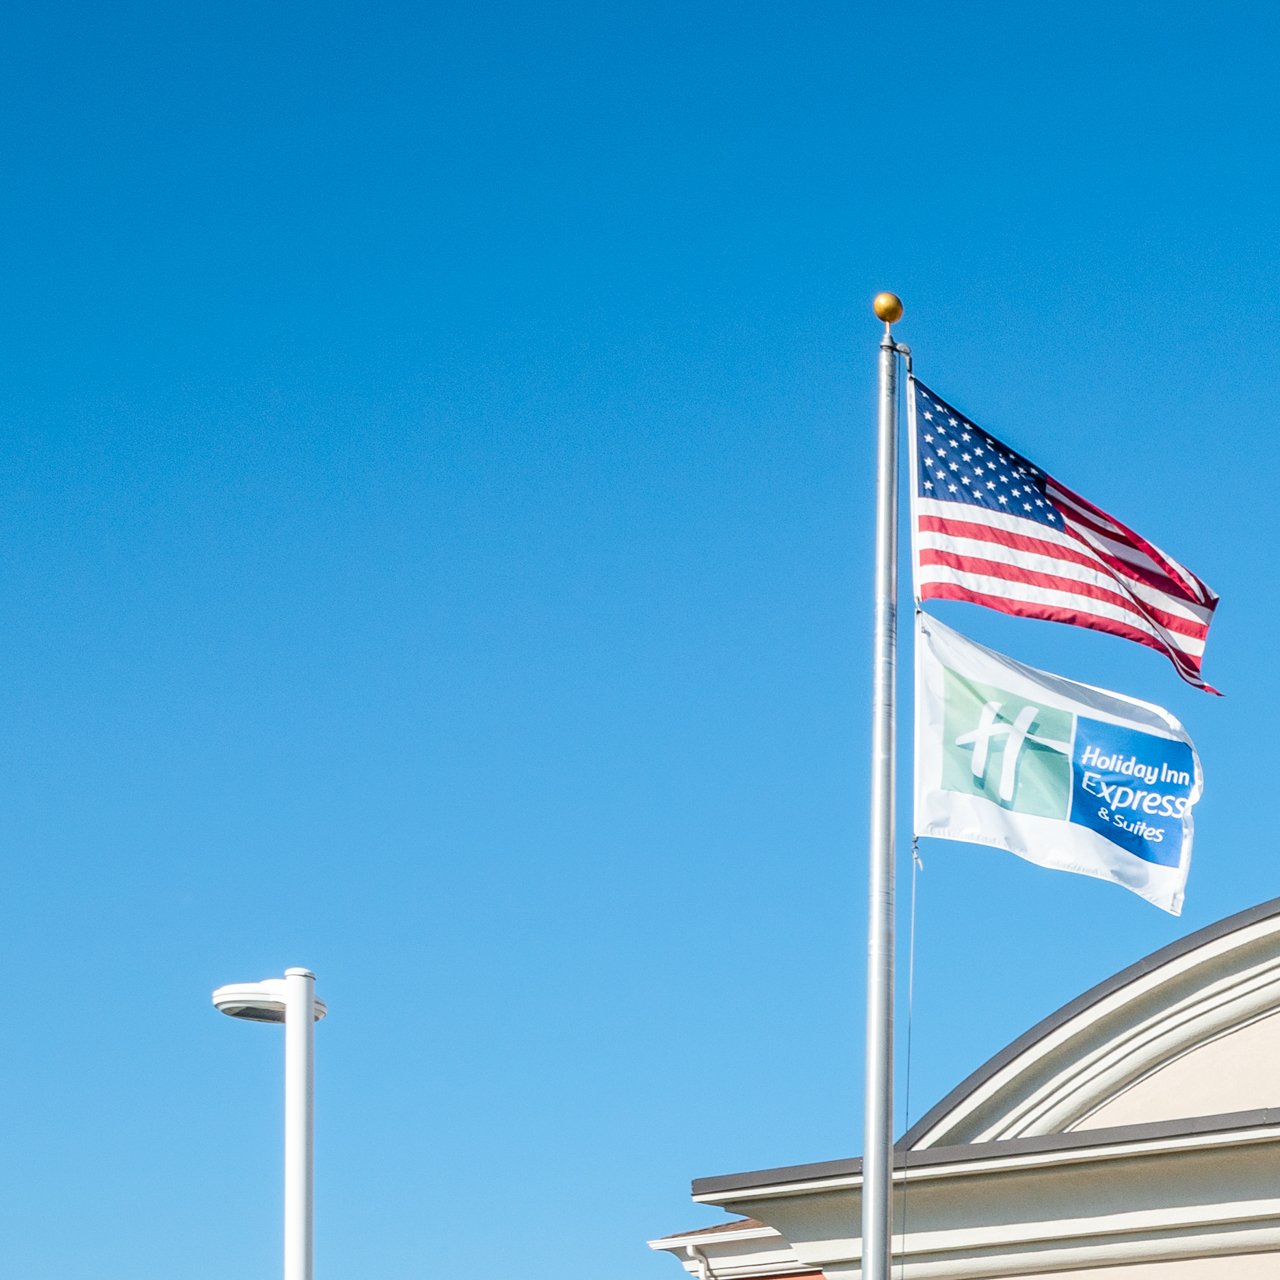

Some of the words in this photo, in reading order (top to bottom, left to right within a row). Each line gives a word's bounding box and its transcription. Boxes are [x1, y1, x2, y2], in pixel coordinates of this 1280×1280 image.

[1081, 745, 1158, 784] Holiday
[1159, 762, 1191, 786] Inn
[1081, 771, 1192, 819] Express
[1097, 807, 1110, 821] &
[1113, 811, 1165, 843] Suites
